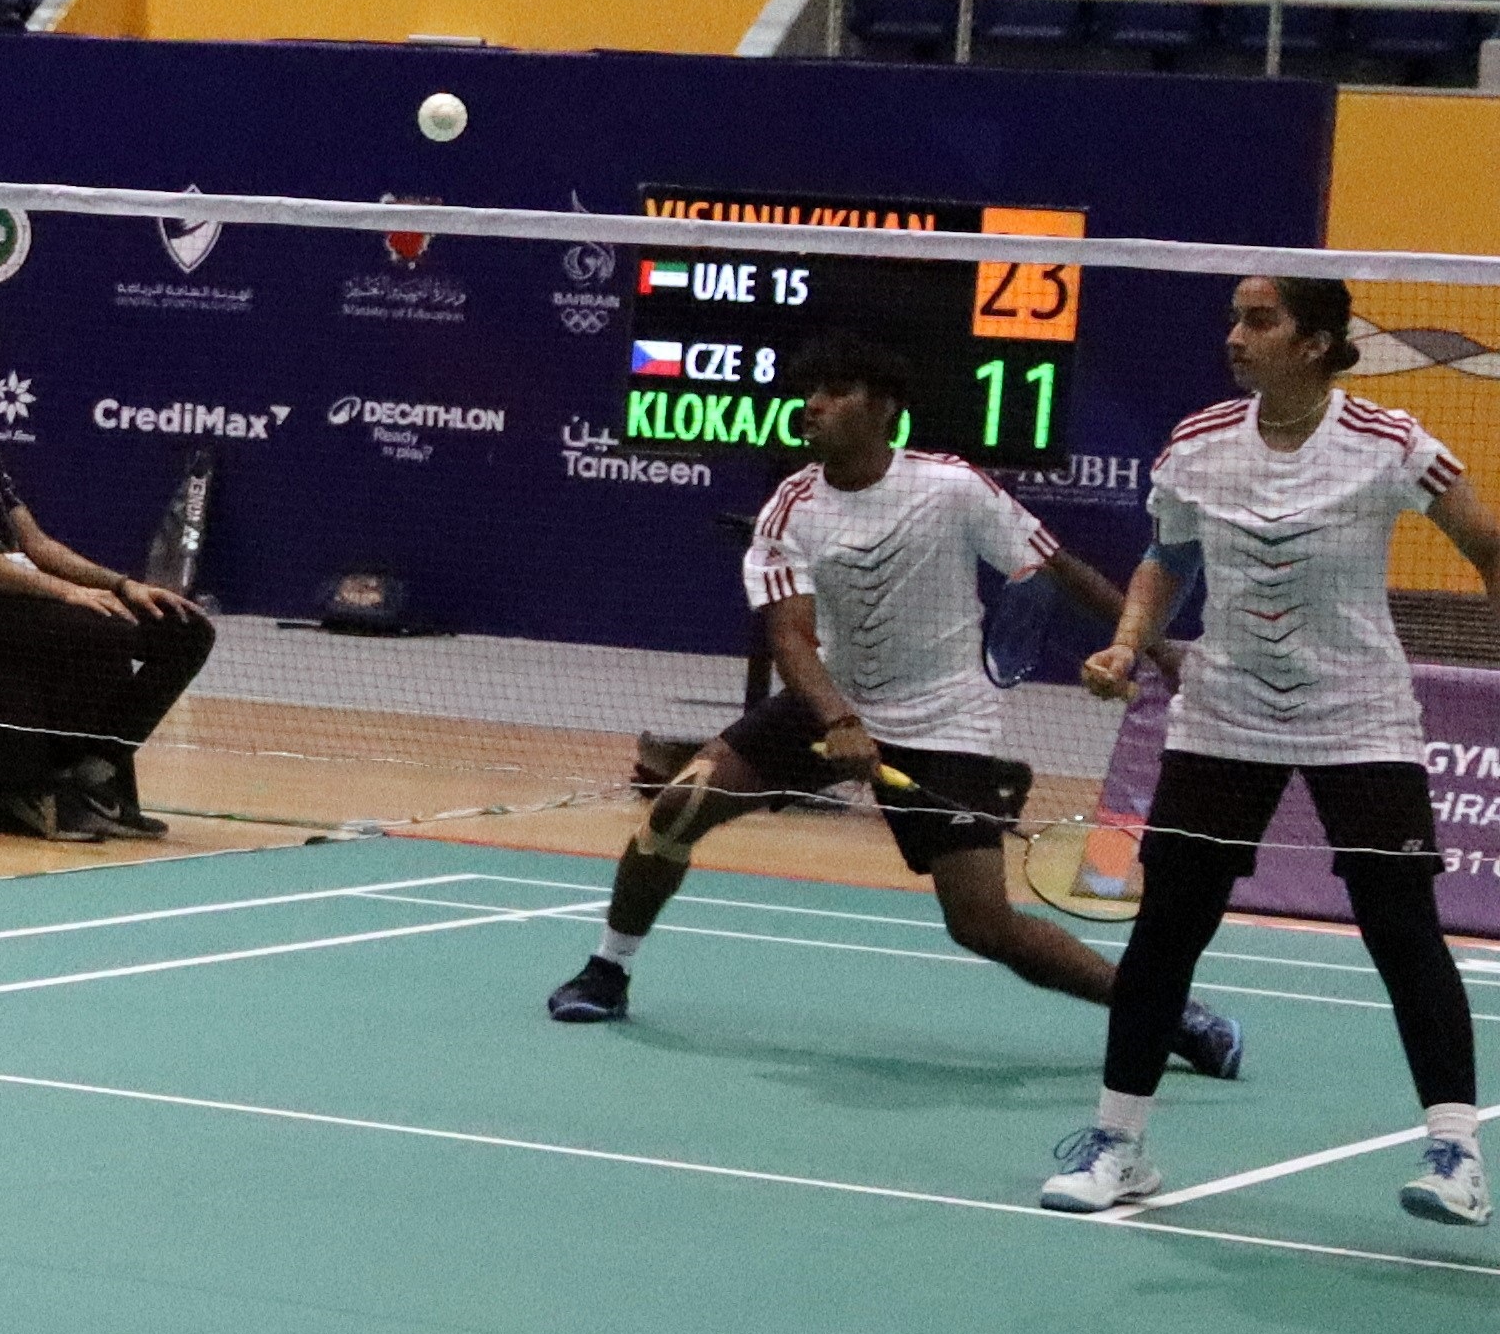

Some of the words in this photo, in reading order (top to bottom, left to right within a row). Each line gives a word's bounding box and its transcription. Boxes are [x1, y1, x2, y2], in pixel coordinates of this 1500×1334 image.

[693, 262, 757, 303] UAE
[771, 267, 810, 306] 15
[979, 240, 1070, 321] 23
[684, 342, 743, 381] CZE
[753, 347, 776, 384] 8
[93, 397, 271, 441] CrediMax
[363, 401, 505, 432] DECATHLON
[975, 359, 1056, 450] 11
[562, 448, 712, 487] Tamkeen
